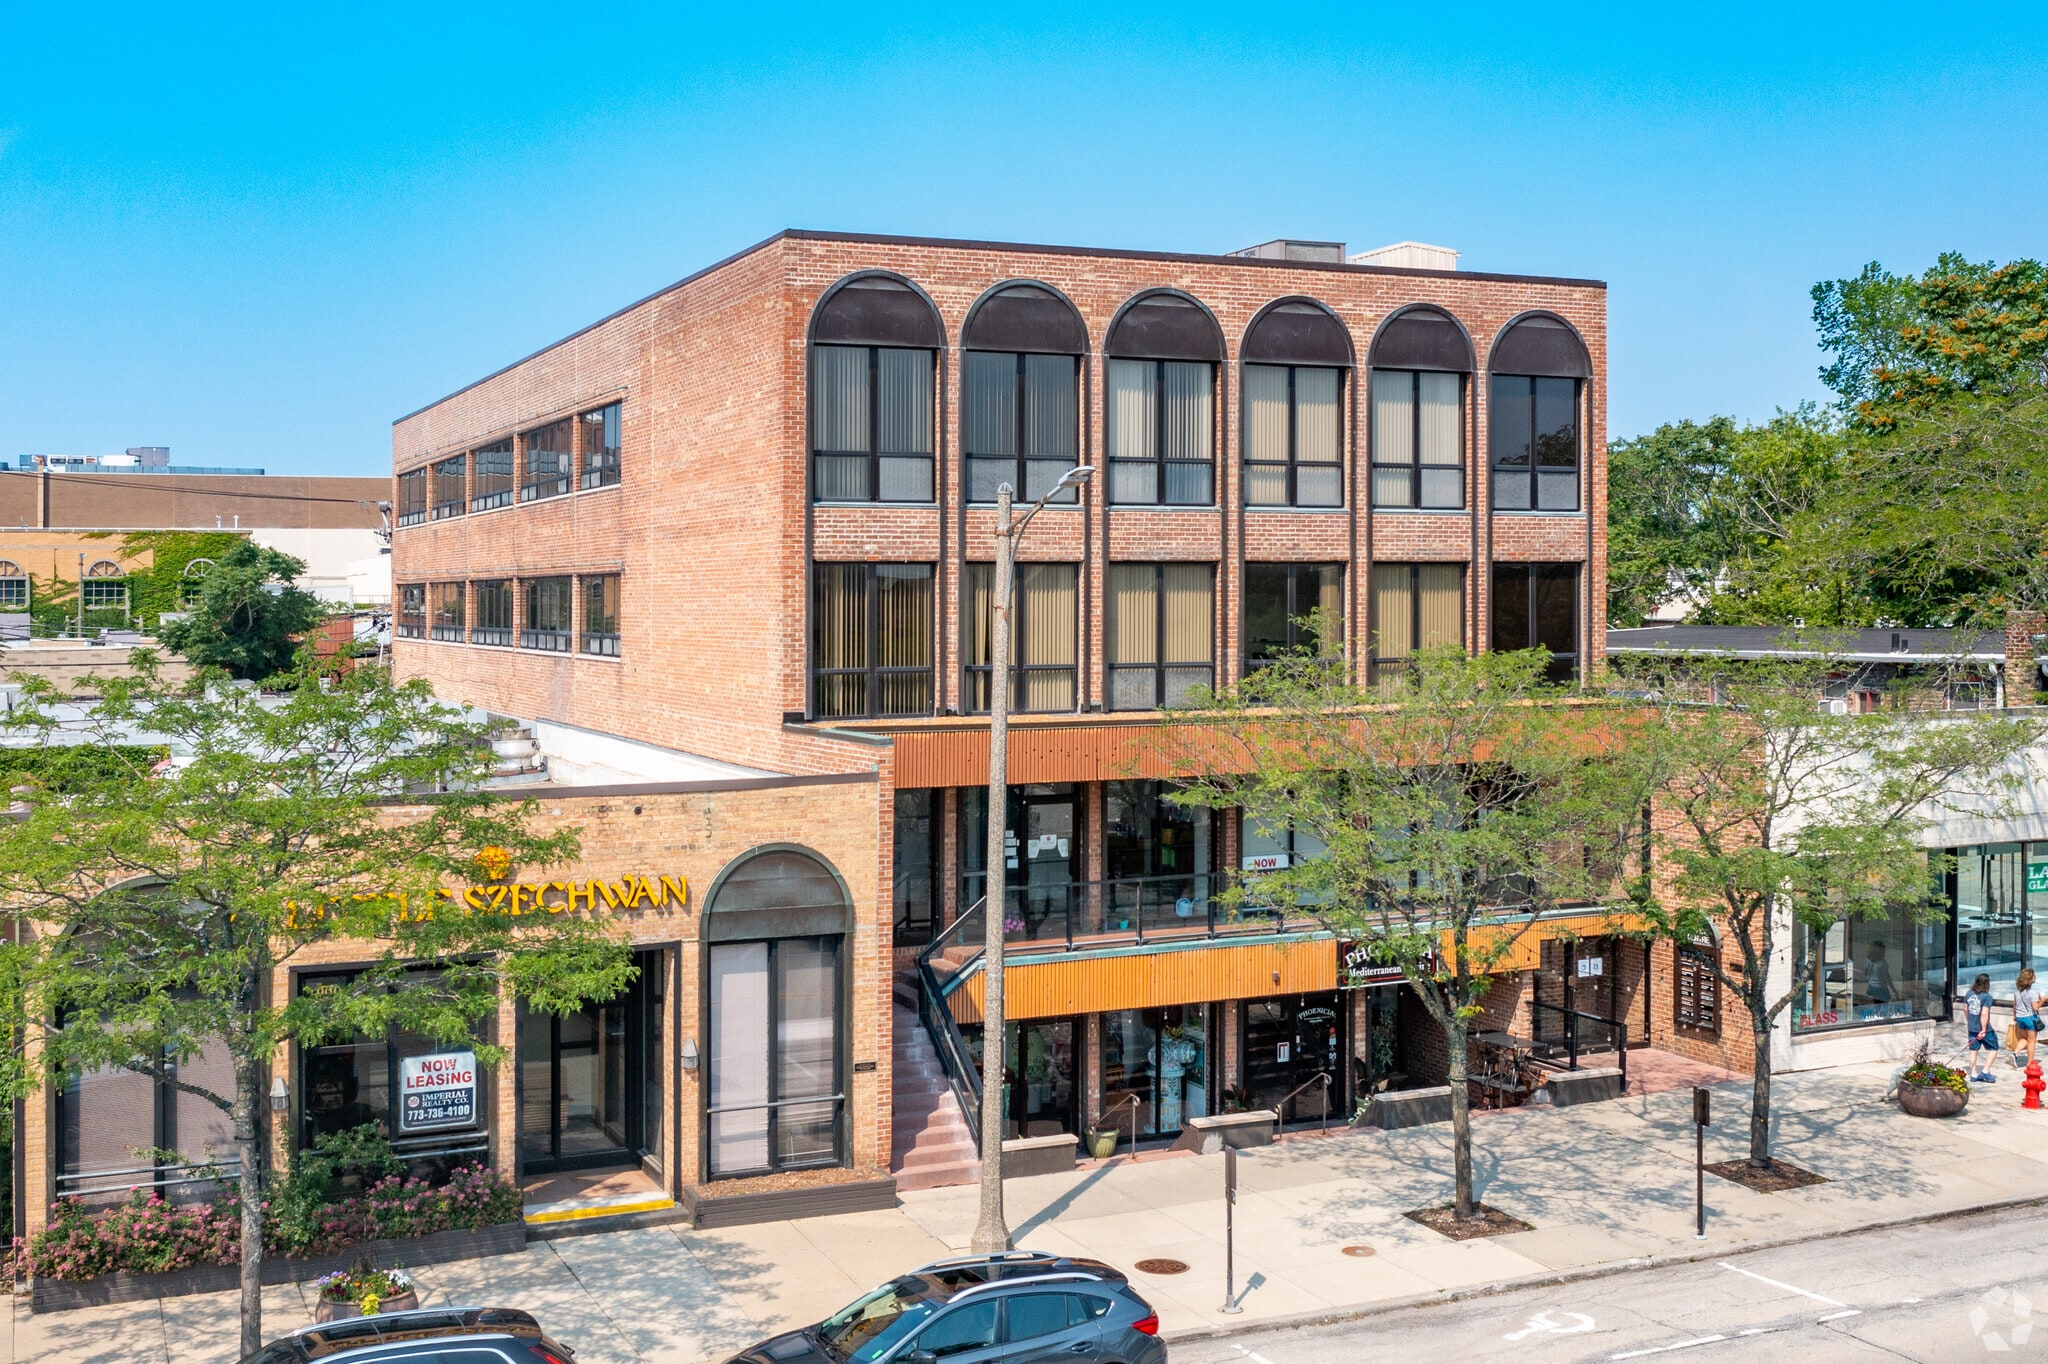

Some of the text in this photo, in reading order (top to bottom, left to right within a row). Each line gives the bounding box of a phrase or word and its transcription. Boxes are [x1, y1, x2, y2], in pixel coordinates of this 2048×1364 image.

[1254, 858, 1277, 868] NOW
[463, 873, 687, 916] SZECHWAN
[1349, 965, 1402, 978] Mediterranean
[1298, 1007, 1334, 1020] PHOENICIA
[1800, 1011, 1838, 1027] GLASS
[421, 1059, 457, 1073] NOW
[406, 1071, 472, 1088] LEASING
[422, 1090, 468, 1101] IMPERIAL
[422, 1099, 453, 1107] REALTY
[408, 1105, 470, 1120] 773-736-4100
